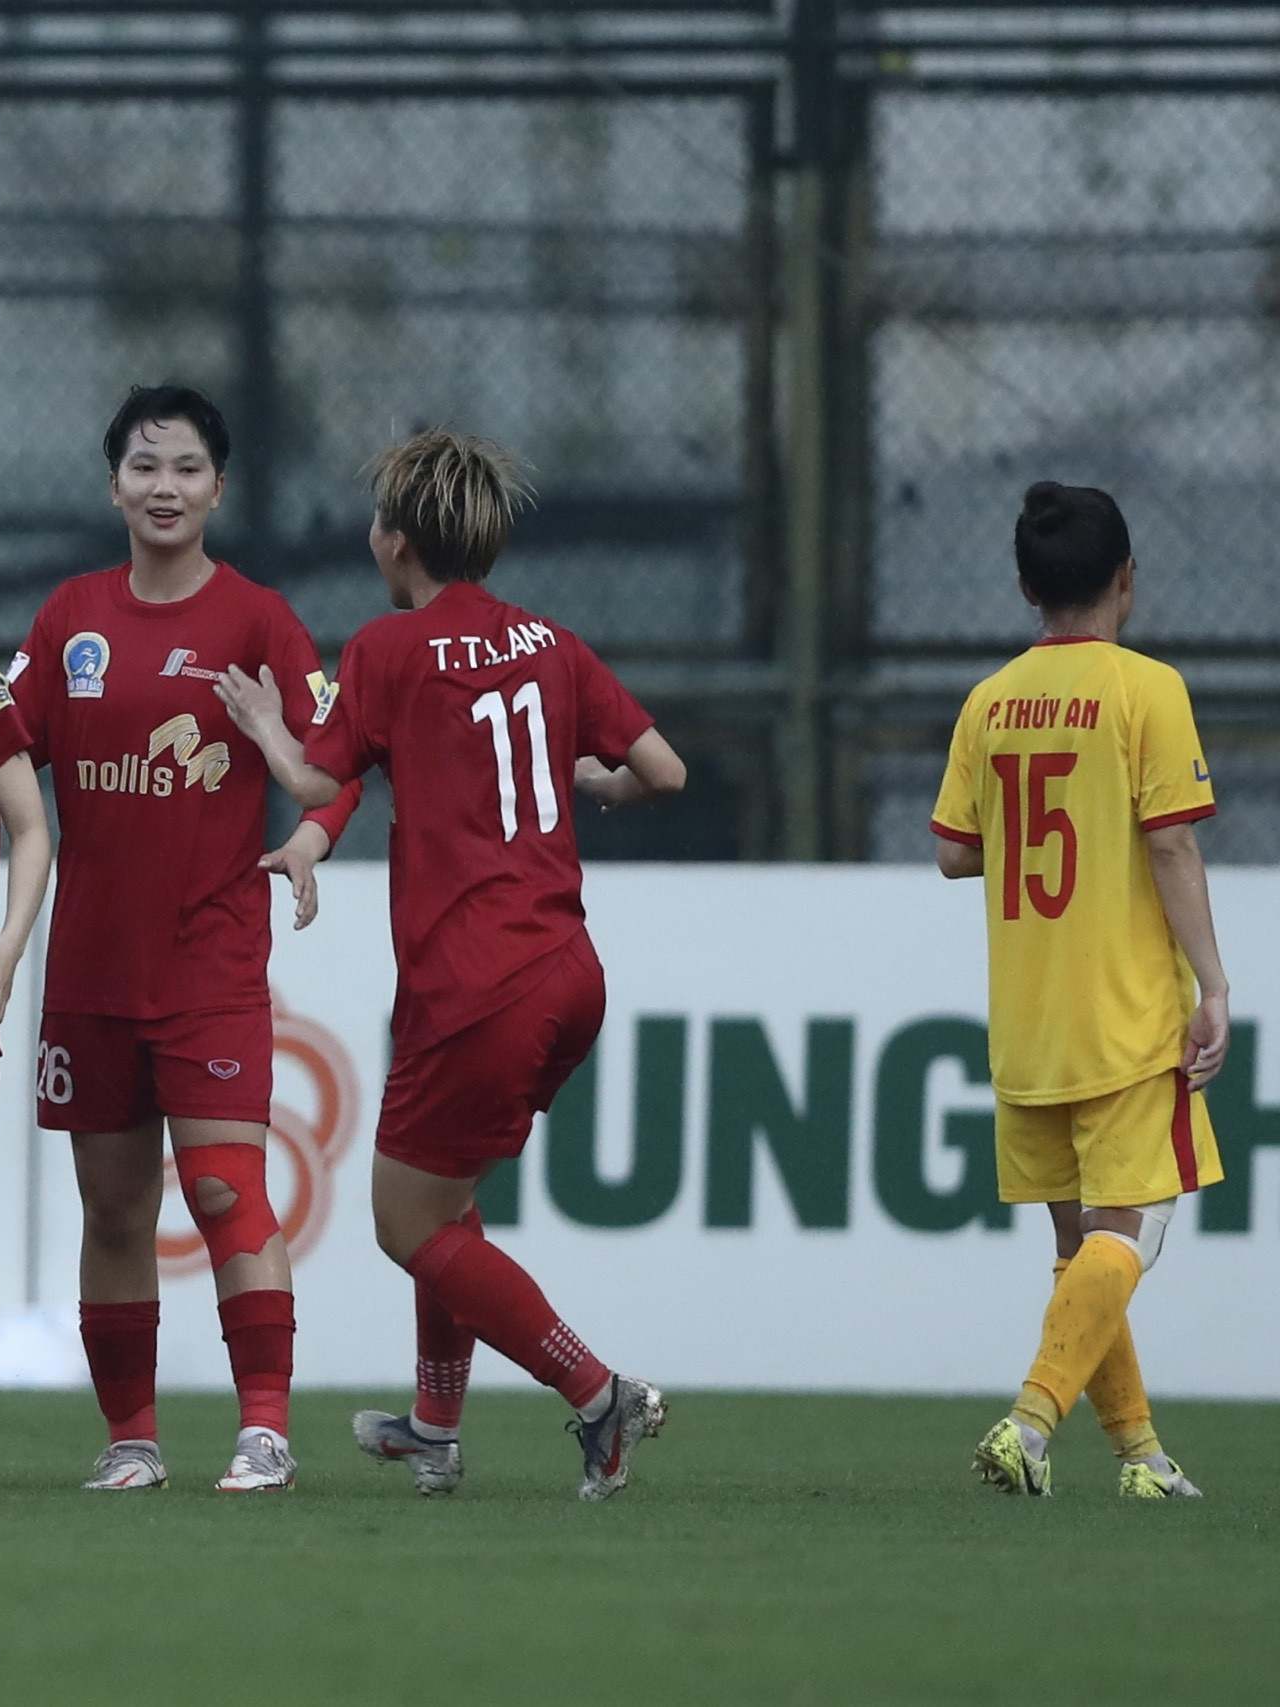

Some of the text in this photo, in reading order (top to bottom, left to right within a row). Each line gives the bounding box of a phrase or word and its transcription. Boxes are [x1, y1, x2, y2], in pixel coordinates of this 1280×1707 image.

[471, 681, 559, 842] 11
[1064, 697, 1101, 730] AN
[990, 752, 1079, 921] 15
[382, 1010, 1013, 1232] UNG
